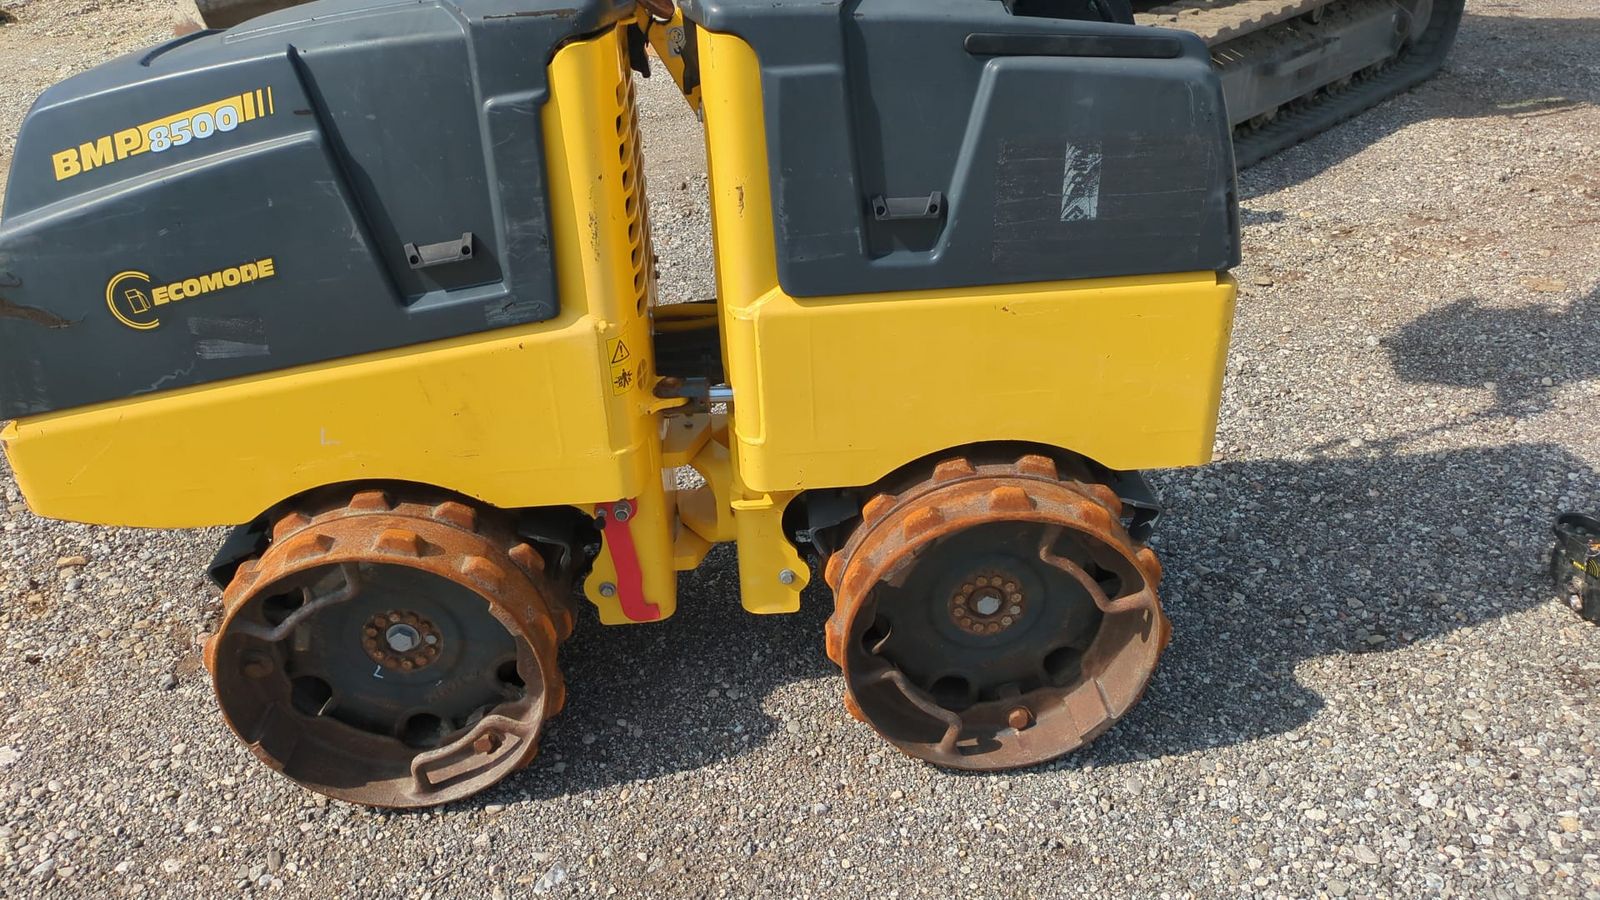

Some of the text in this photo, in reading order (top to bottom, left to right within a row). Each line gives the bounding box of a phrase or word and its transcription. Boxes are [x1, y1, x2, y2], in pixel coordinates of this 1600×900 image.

[52, 105, 239, 181] BMP 8500
[151, 257, 275, 306] ECOMODE
